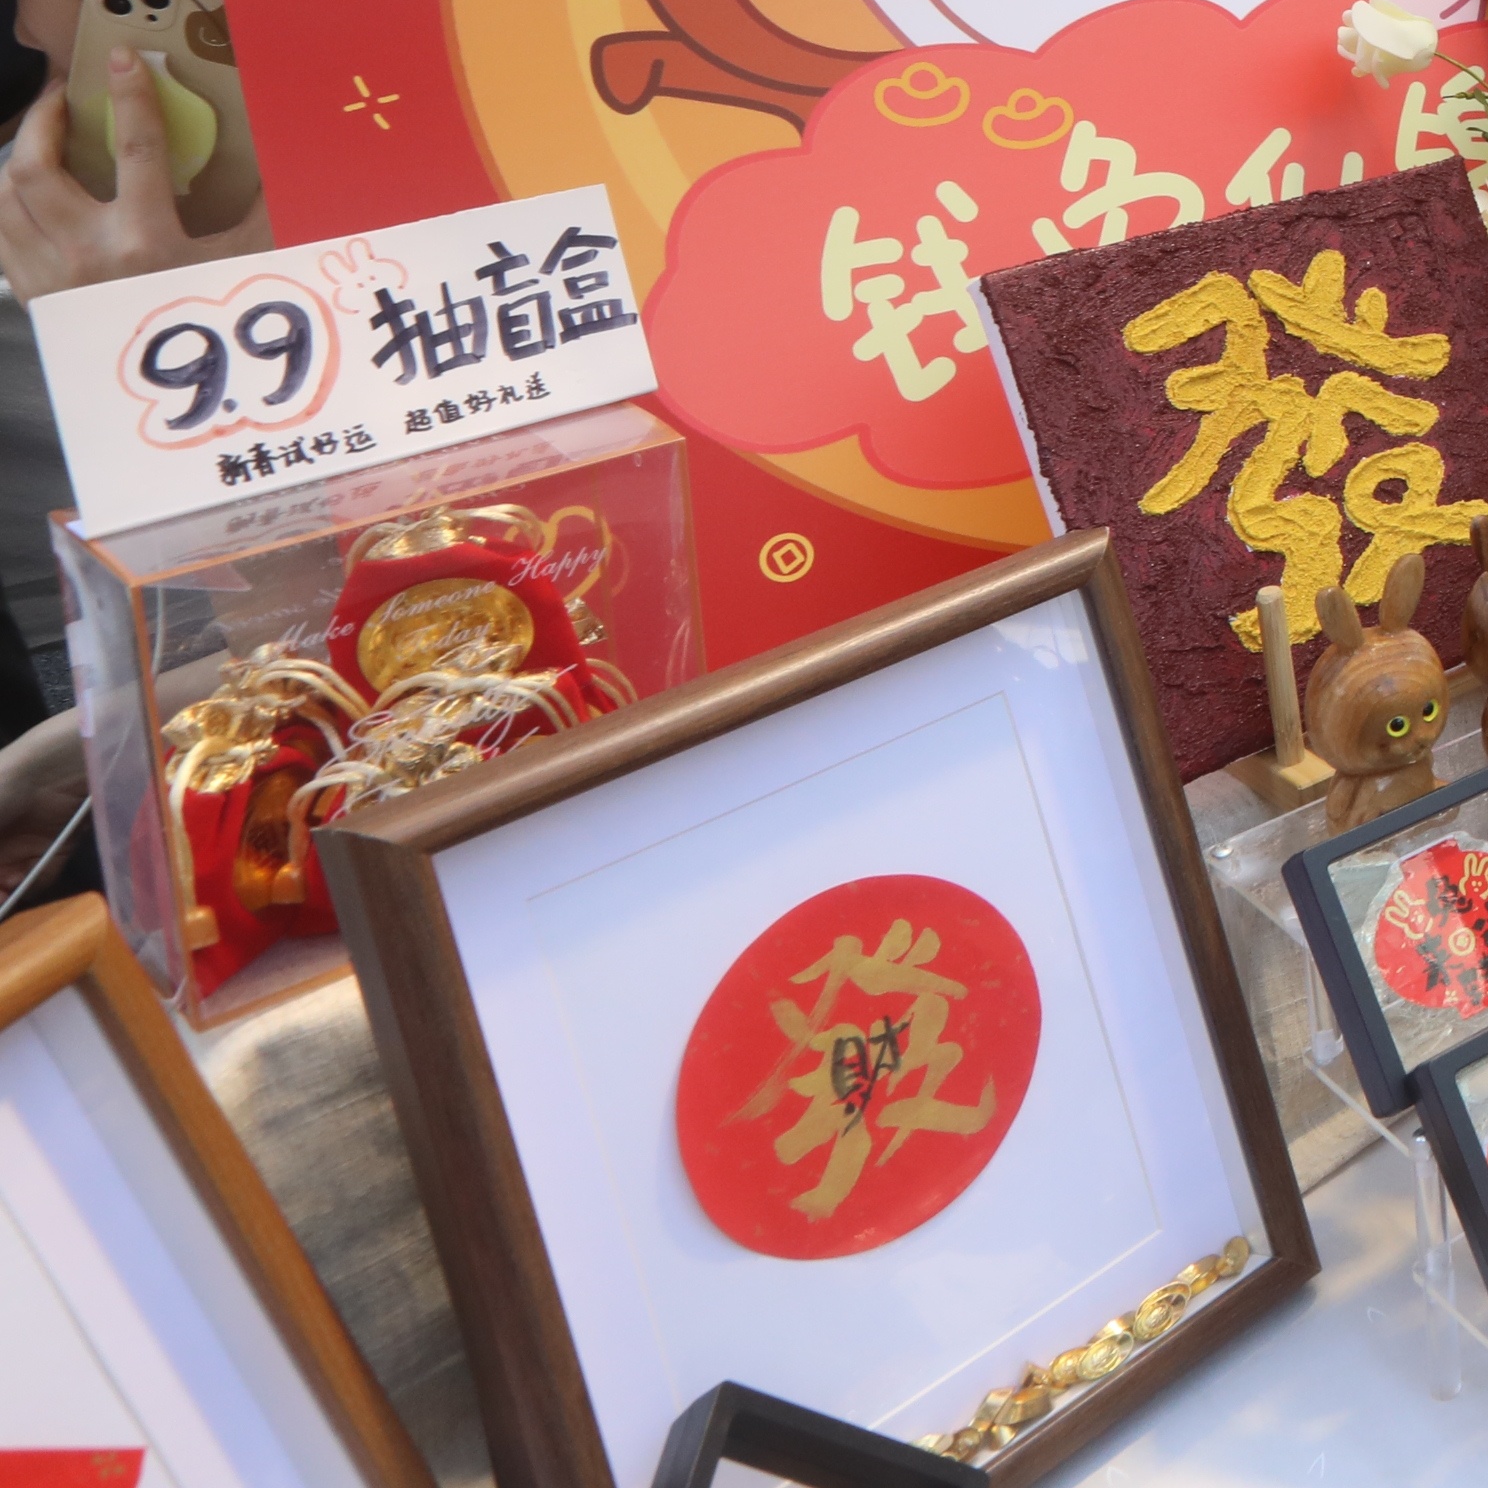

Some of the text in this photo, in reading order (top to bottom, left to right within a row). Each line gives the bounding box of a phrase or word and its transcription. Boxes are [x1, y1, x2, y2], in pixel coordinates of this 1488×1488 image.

[141, 226, 637, 429] 9.9 抽盲盒
[217, 373, 551, 486] 新春试好运 超值好礼送
[508, 546, 606, 586] Happy
